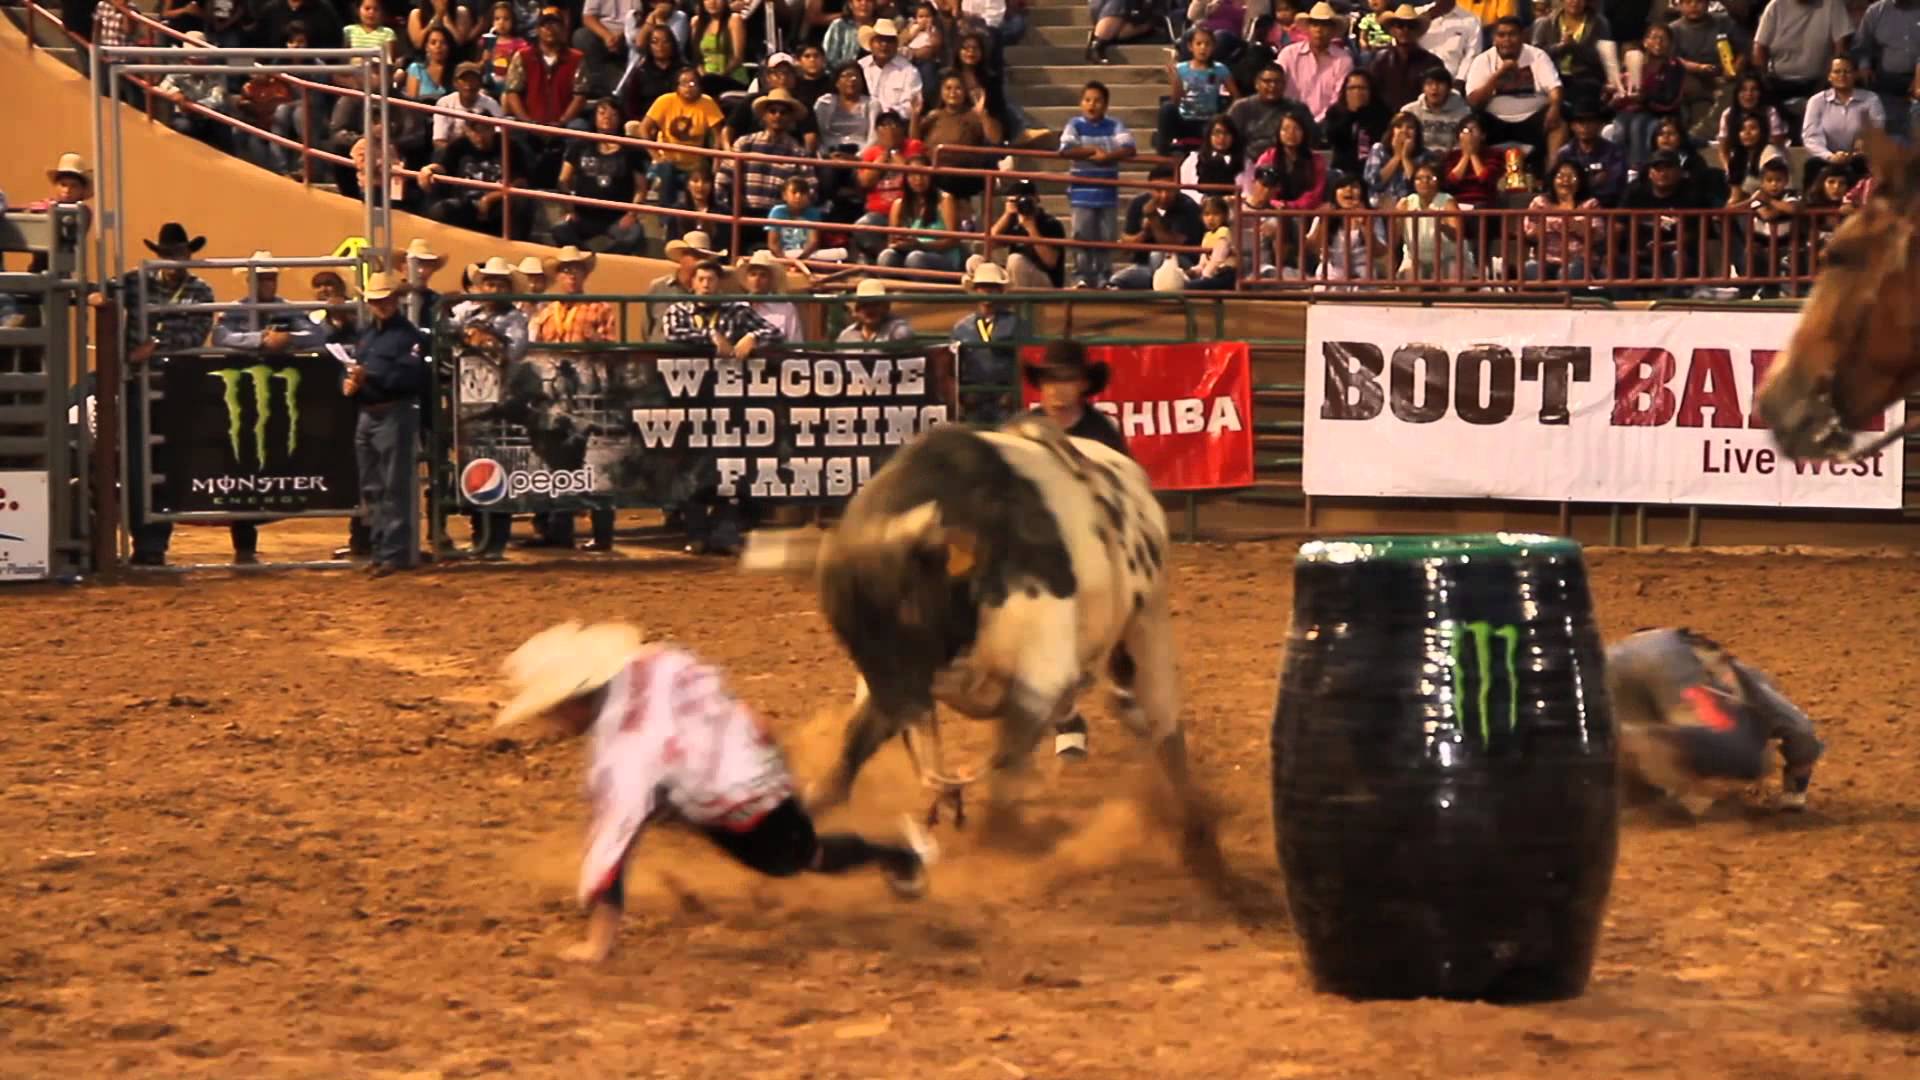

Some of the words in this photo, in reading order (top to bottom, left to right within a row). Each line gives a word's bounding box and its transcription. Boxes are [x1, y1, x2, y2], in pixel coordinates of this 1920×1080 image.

[657, 357, 926, 397] WELCOME
[1320, 341, 1592, 426] BOOT
[1610, 346, 1885, 431] BA
[632, 408, 775, 448] WILD
[1029, 396, 1242, 438] HIBA
[716, 456, 871, 496] FANS!
[1703, 439, 1775, 474] Live
[192, 475, 328, 494] MONSTER
[509, 466, 593, 498] pepsi
